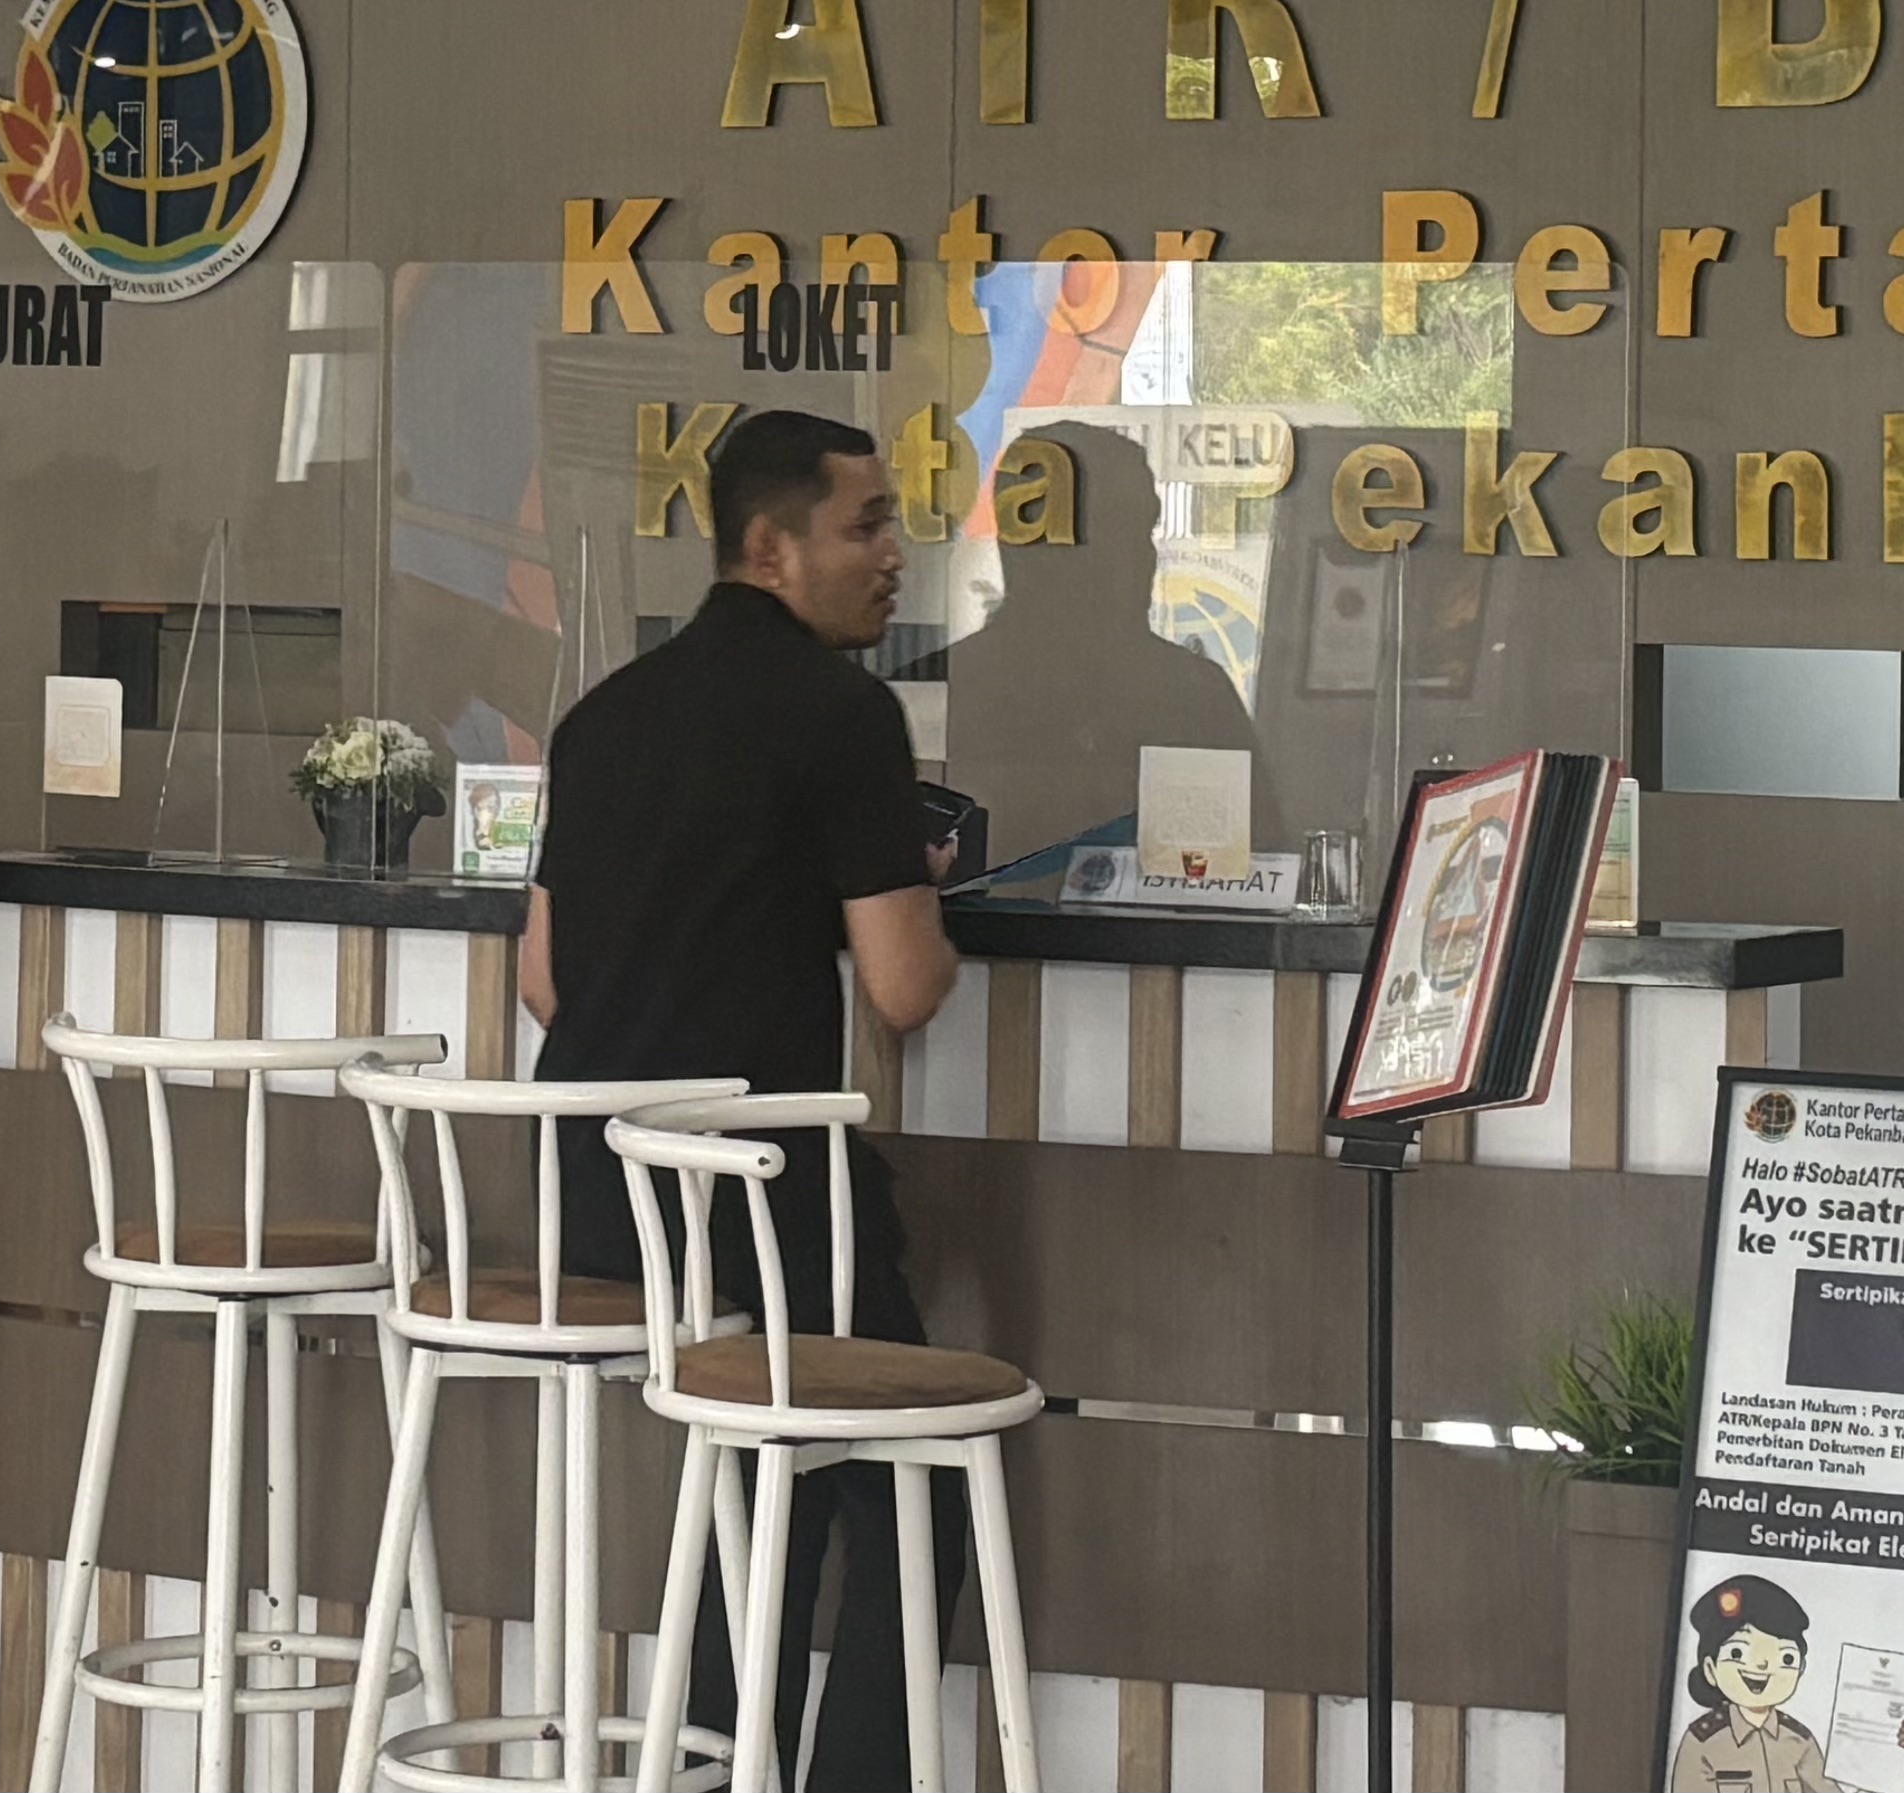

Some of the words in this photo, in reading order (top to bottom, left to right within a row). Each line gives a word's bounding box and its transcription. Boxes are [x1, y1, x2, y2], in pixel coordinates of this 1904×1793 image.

[58, 243, 95, 280] BADAN
[561, 194, 1220, 336] Kantor
[743, 284, 896, 371] LOKET
[636, 404, 1076, 547] Kta
[1806, 1099, 1861, 1119] Kantor
[1804, 1119, 1841, 1139] Kota
[1742, 1157, 1788, 1181] Halo
[1739, 1188, 1807, 1222] Ayo
[1737, 1224, 1776, 1254] ke
[1721, 1392, 1795, 1410] Landasan
[1802, 1398, 1856, 1415] Hukum
[1717, 1411, 1806, 1431] ATR/Kepala
[1811, 1419, 1843, 1434] BPN
[1848, 1422, 1875, 1438] No.
[1879, 1425, 1889, 1438] 3
[1715, 1450, 1813, 1472] Pendaftaran
[1819, 1459, 1866, 1476] Tanah
[1809, 1438, 1885, 1458] Dokumen
[1696, 1488, 1768, 1514] Andal
[1776, 1494, 1822, 1519] dan
[1831, 1501, 1904, 1526] Aman
[1749, 1524, 1871, 1555] Sertipikat
